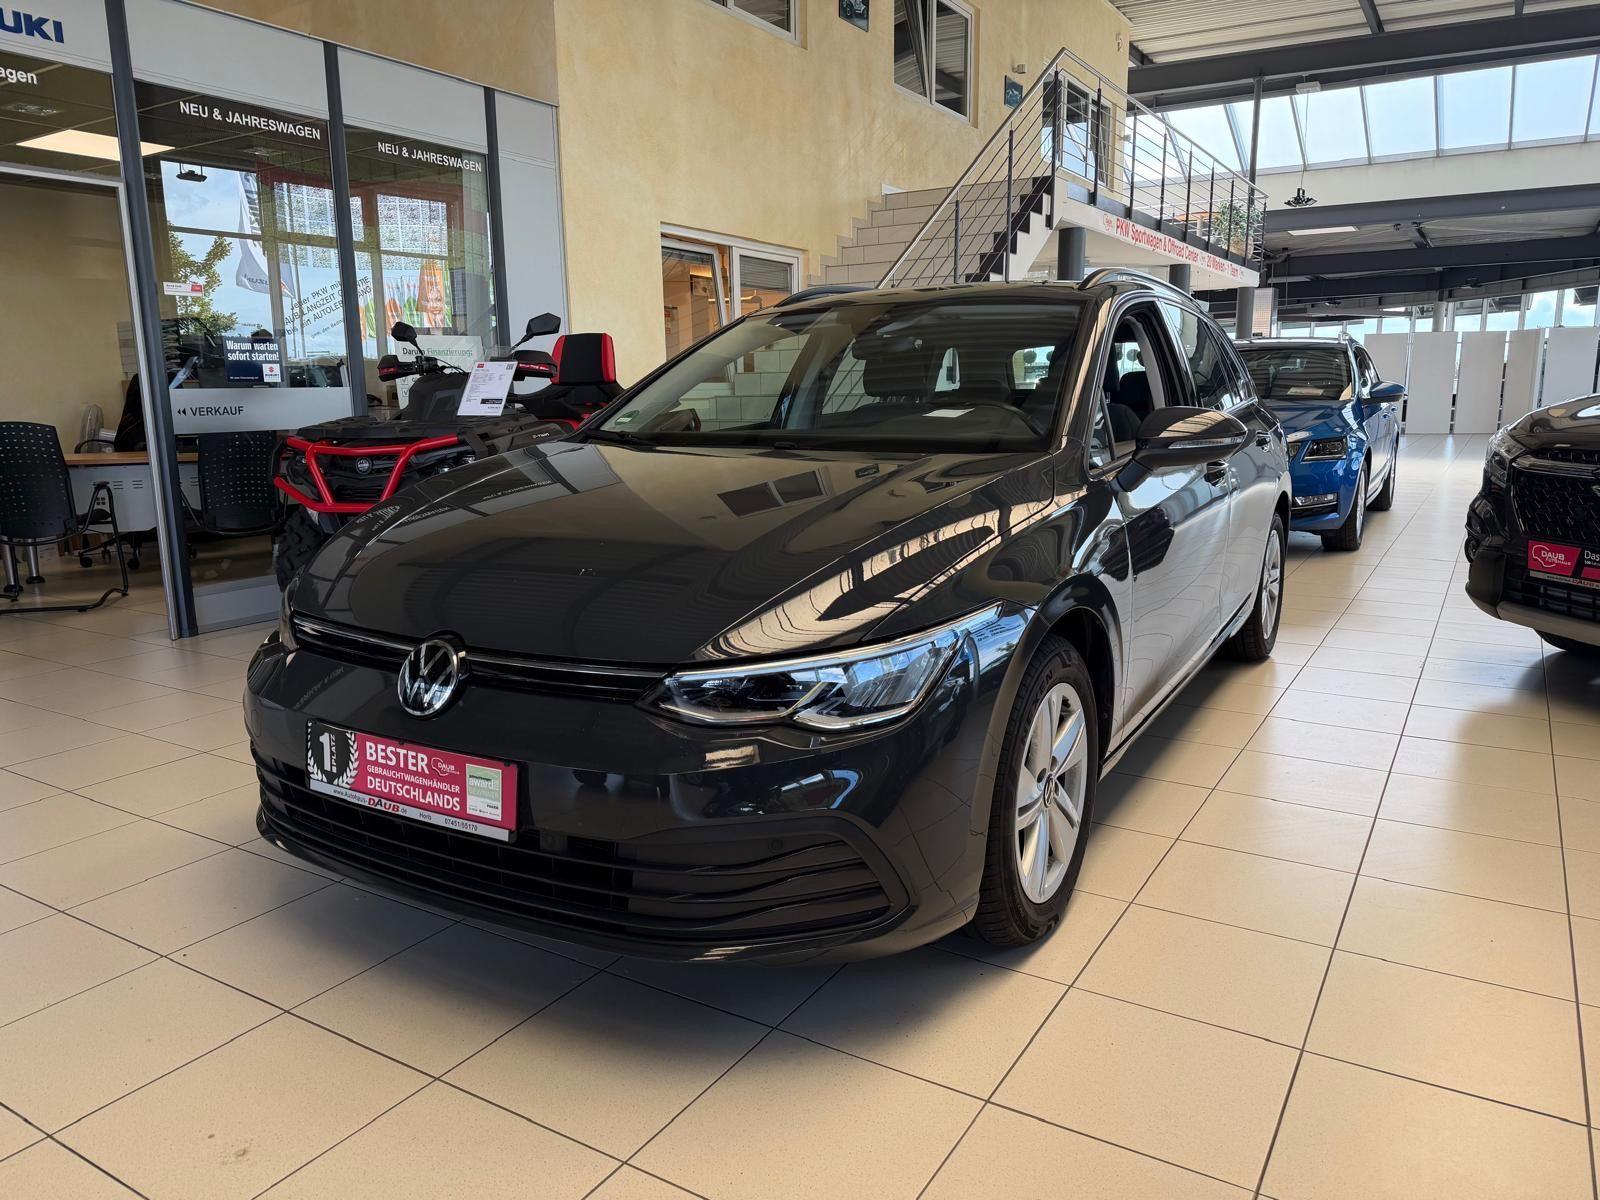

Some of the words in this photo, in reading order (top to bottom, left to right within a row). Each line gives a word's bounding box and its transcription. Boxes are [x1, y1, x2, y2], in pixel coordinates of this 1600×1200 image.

[180, 101, 208, 118] NEU
[212, 108, 222, 121] &
[226, 111, 320, 140] JAHRESWAGEN
[377, 141, 399, 155] NEU
[402, 146, 409, 158] &
[411, 149, 482, 172] JAHRESWAGEN
[1116, 218, 1131, 237] PKW
[1131, 224, 1162, 252] Sportwagen
[302, 292, 336, 316] LANGZEIT
[311, 286, 328, 300] PKW
[226, 340, 252, 350] Warum
[253, 342, 279, 351] warten
[228, 351, 251, 361] sofort
[252, 352, 280, 361] starten!
[190, 405, 244, 417] VERKAUF
[1541, 550, 1565, 561] DAUB
[1584, 550, 1600, 561] Das
[366, 741, 429, 775] BESTER
[366, 764, 460, 793] GEBRAUCHTWAGENHÄNDLER
[367, 775, 460, 811] DEUTSCHLANDS
